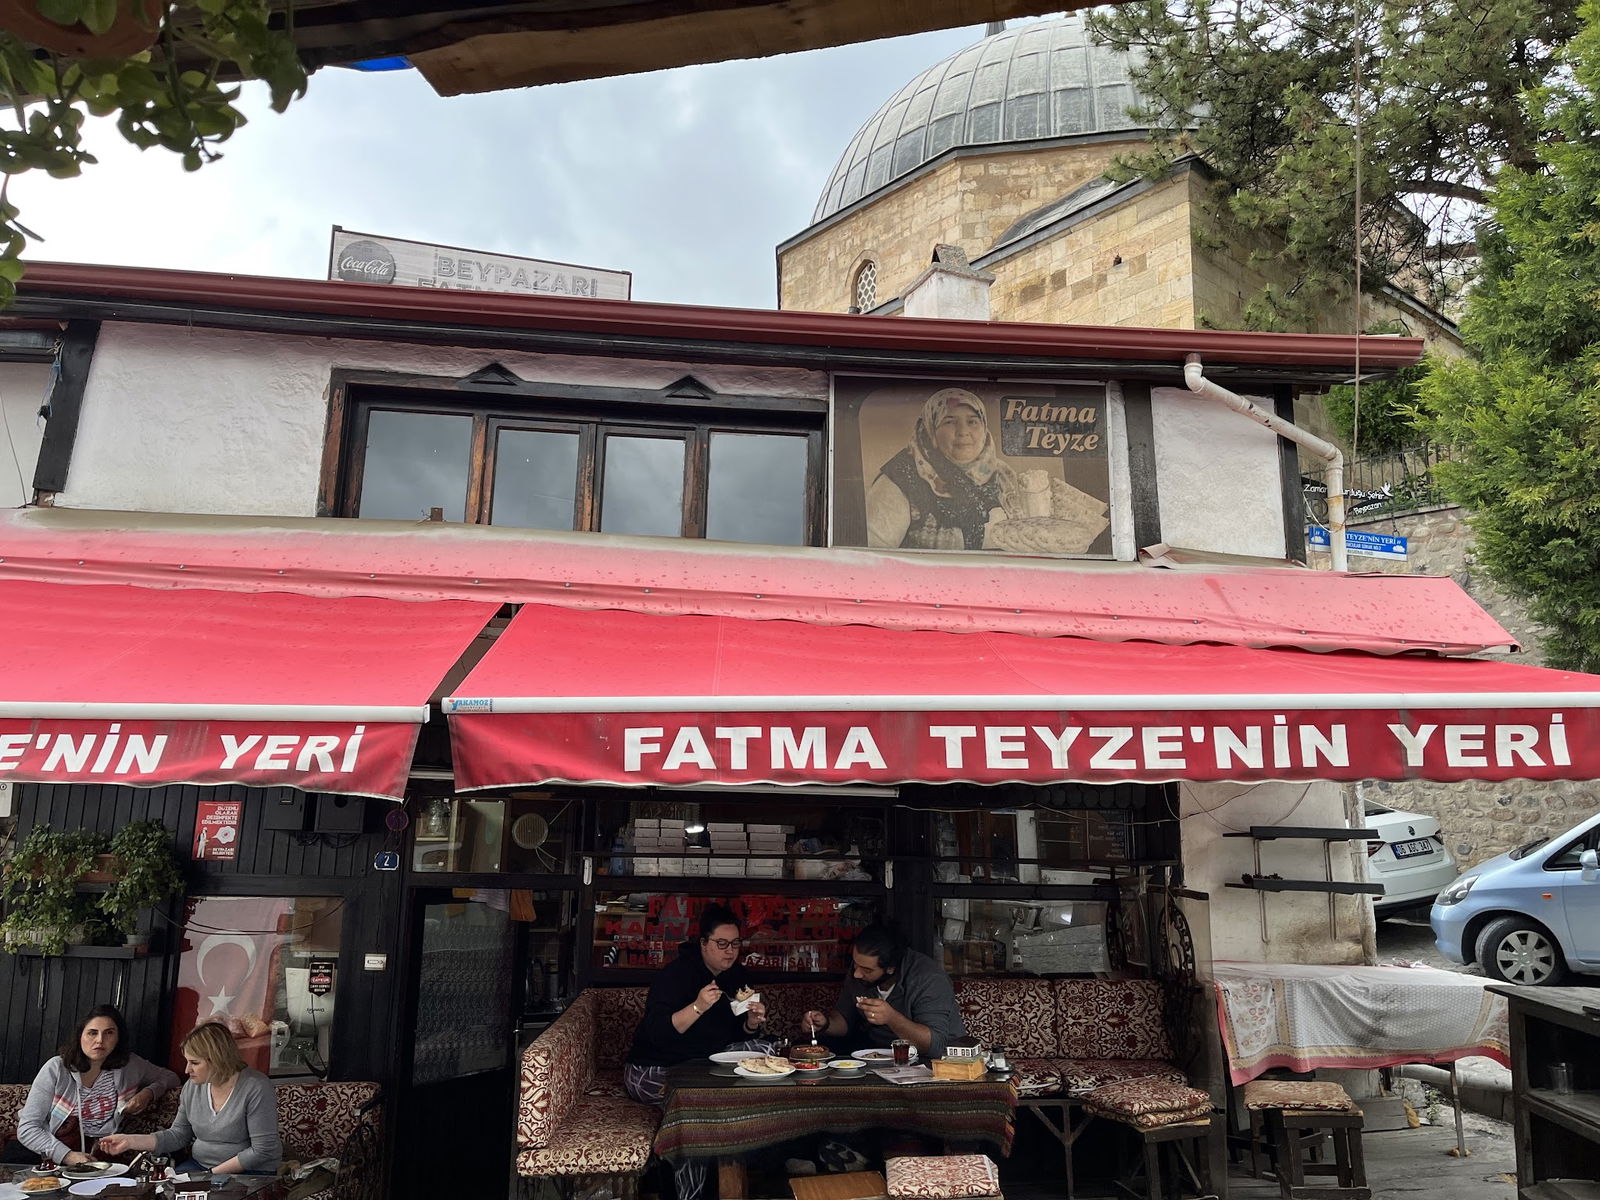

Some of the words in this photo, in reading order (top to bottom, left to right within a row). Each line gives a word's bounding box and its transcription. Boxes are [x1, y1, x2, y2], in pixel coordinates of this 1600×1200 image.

[437, 255, 598, 298] BEYPAZARI
[1004, 398, 1097, 424] Fatma
[1025, 425, 1099, 455] Teyze
[219, 725, 366, 773] YERİ
[623, 726, 888, 772] FATMA
[929, 714, 1350, 770] TEYZE'NİN
[1386, 713, 1572, 768] YERİ
[383, 855, 390, 867] 2
[81, 1096, 113, 1120] AP
